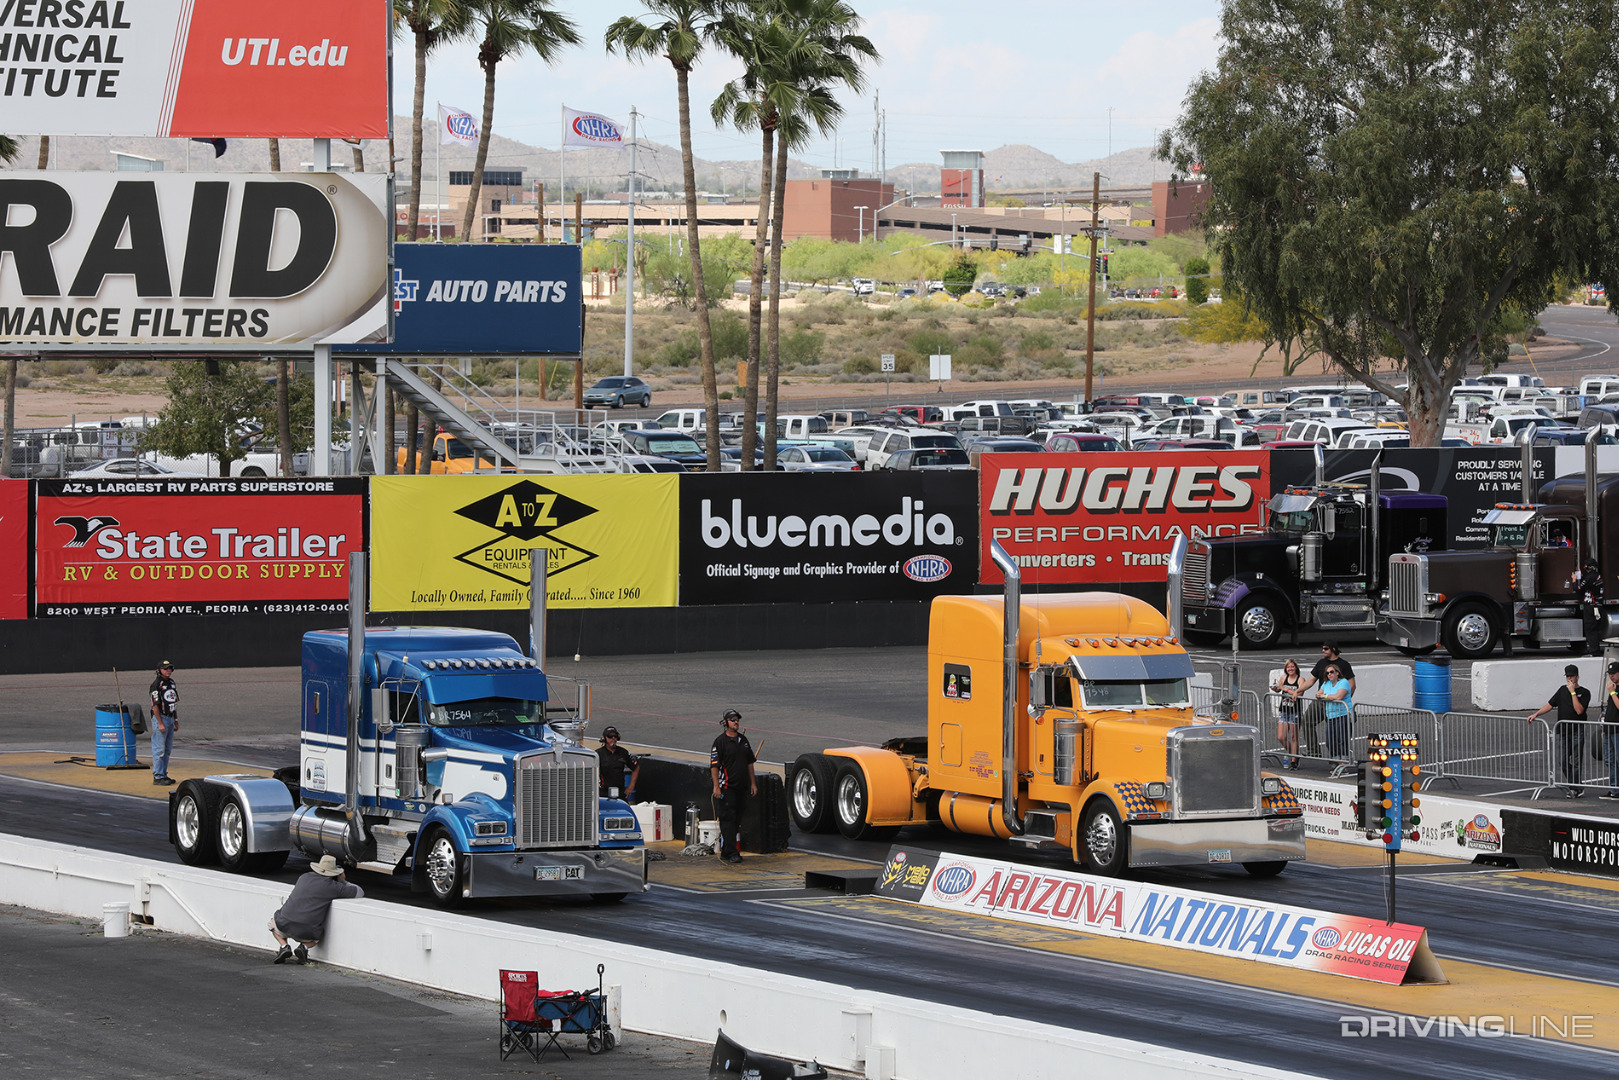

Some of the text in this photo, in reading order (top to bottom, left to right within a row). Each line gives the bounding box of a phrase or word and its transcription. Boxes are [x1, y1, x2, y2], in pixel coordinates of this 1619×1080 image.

[221, 37, 349, 67] UTI.edu
[0, 68, 120, 98] ITUTE
[581, 119, 617, 137] NHRA
[425, 279, 489, 302] AUTO
[494, 280, 568, 303] PARTS
[130, 308, 270, 338] FILTERS
[883, 363, 894, 371] 35
[1457, 460, 1496, 470] PROUDLY
[1455, 471, 1508, 480] CUSTOMERS
[62, 481, 334, 494] AZ's LARGEST RV PARTS SUPERSTORE
[989, 465, 1260, 513] HUGHES
[1478, 482, 1521, 491] AT A TIME
[495, 494, 558, 527] A TO Z
[96, 526, 347, 560] State Trailer
[484, 548, 567, 561] EQUIPNT
[1012, 552, 1096, 567] onverters
[63, 563, 345, 581] RV & OUTDOOR SUPPLY
[706, 560, 900, 579] Official Signage and Graphics Provider of
[911, 560, 945, 577] NHRA
[411, 590, 447, 606] Locally
[449, 589, 487, 604] Owned,
[490, 588, 524, 605] Family
[589, 587, 615, 600] Since
[617, 588, 641, 600] 1960
[47, 607, 79, 616] 8200
[84, 606, 113, 615] WEST
[121, 605, 165, 615] PEORIA
[205, 605, 249, 613] PEORIA
[1314, 790, 1328, 803] FOR
[1329, 792, 1342, 804] ALL
[1307, 804, 1324, 814] TRUCK
[1324, 806, 1341, 817] NEEDS
[1421, 826, 1438, 841] PASS
[1440, 820, 1453, 830] HOME
[1465, 828, 1500, 844] ARIZONA
[1571, 827, 1595, 844] WILD
[1469, 842, 1497, 851] NATIONALS
[565, 867, 580, 878] CAT
[938, 867, 971, 893] NHRA
[970, 870, 1316, 960] ARIZONA NATIONALS
[1314, 928, 1340, 947] NHRA
[1337, 930, 1417, 963] LUCAS OIL
[1305, 949, 1407, 972] DRAG RACING SERIES
